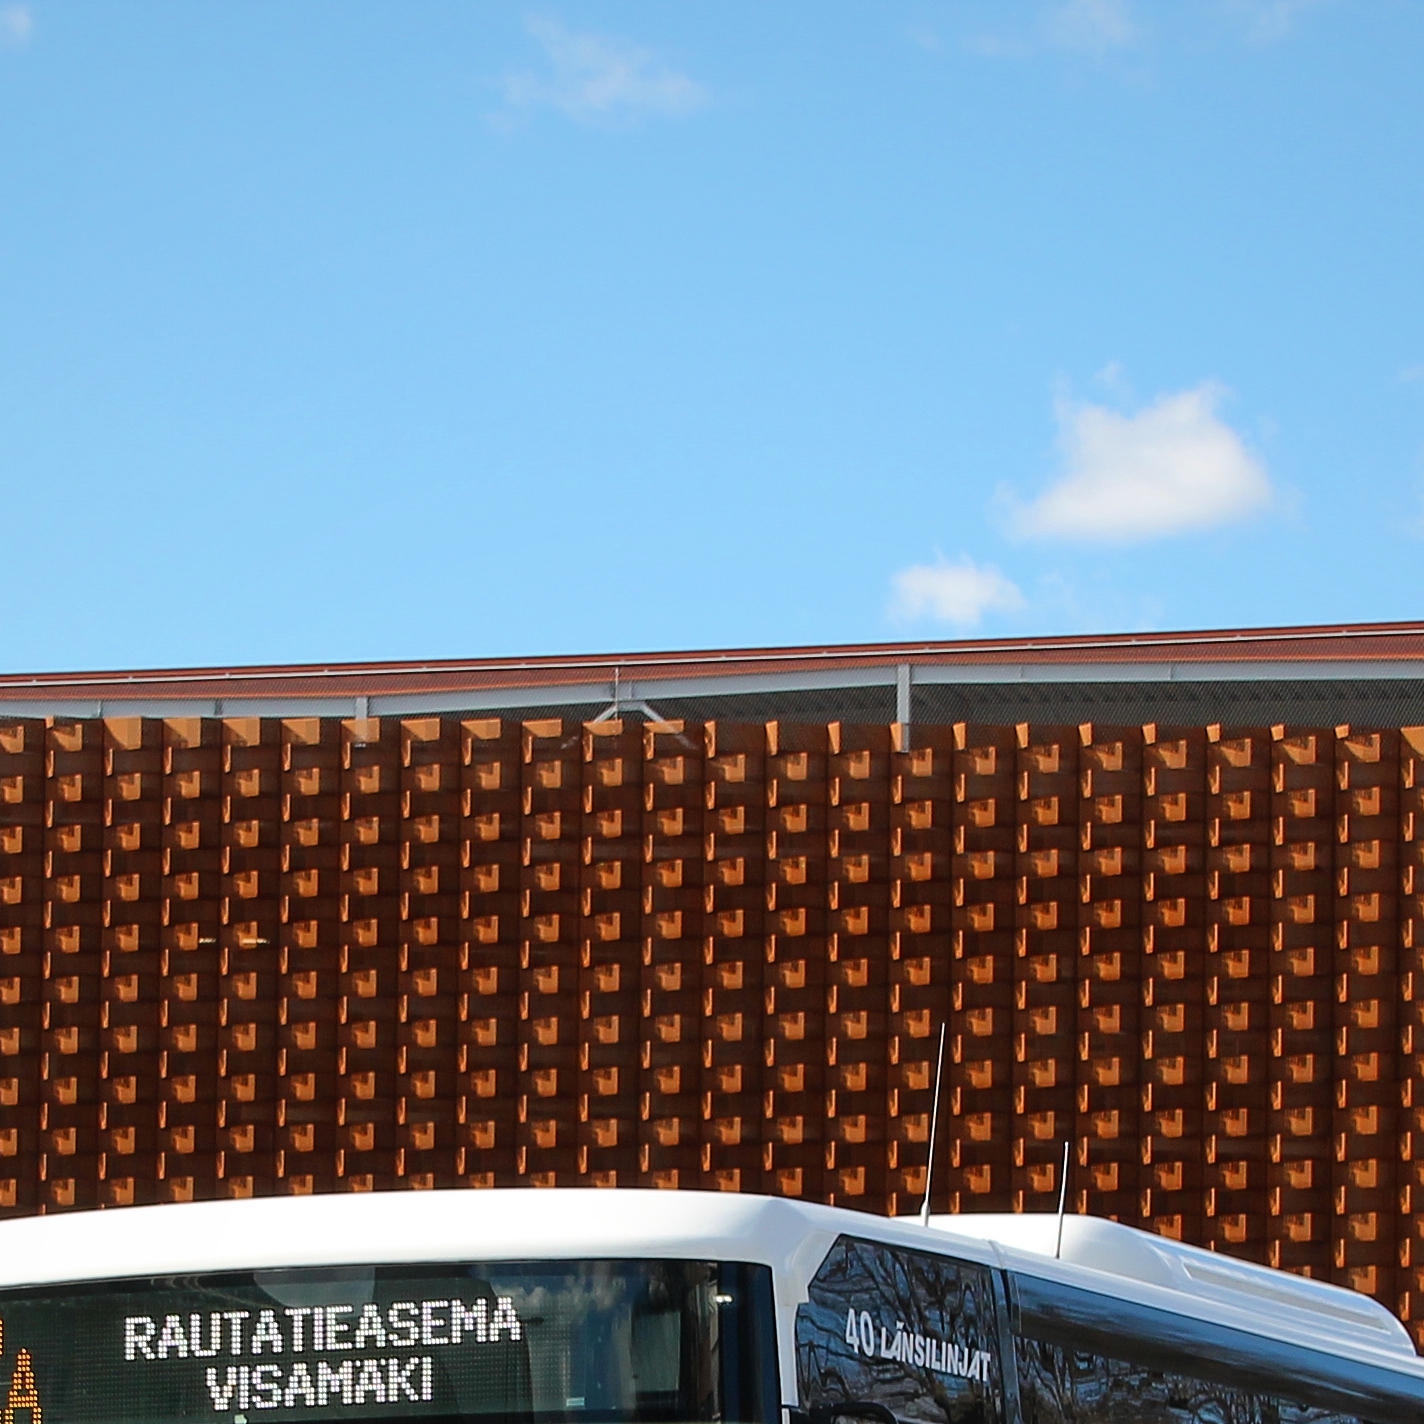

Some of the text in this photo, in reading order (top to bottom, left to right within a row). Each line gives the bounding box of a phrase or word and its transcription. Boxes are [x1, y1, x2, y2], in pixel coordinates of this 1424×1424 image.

[123, 1296, 523, 1361] RAUTATIEASEMA
[845, 1307, 991, 1382] 40 LÄNSILINJAT
[205, 1356, 434, 1411] VISAMÄKI
